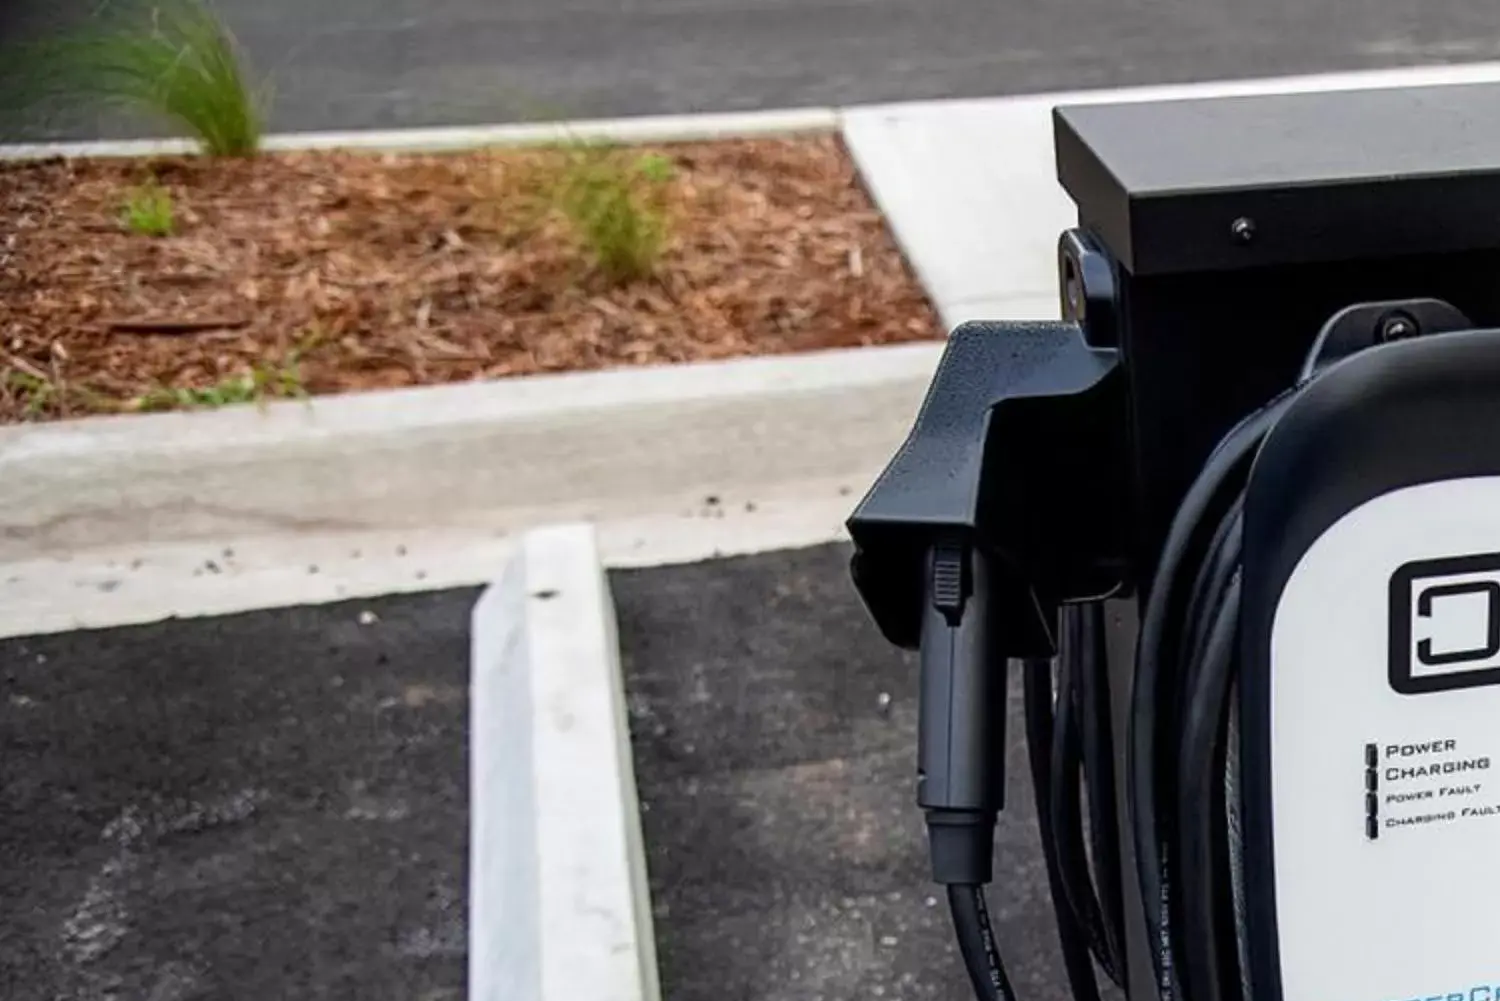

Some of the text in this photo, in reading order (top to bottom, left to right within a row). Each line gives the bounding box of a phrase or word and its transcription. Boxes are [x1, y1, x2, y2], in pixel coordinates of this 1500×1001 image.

[1385, 739, 1457, 759] POWER
[1385, 757, 1490, 781] CHARGING
[1386, 784, 1481, 804] POWER FAULT
[1385, 811, 1455, 827] CHARGING
